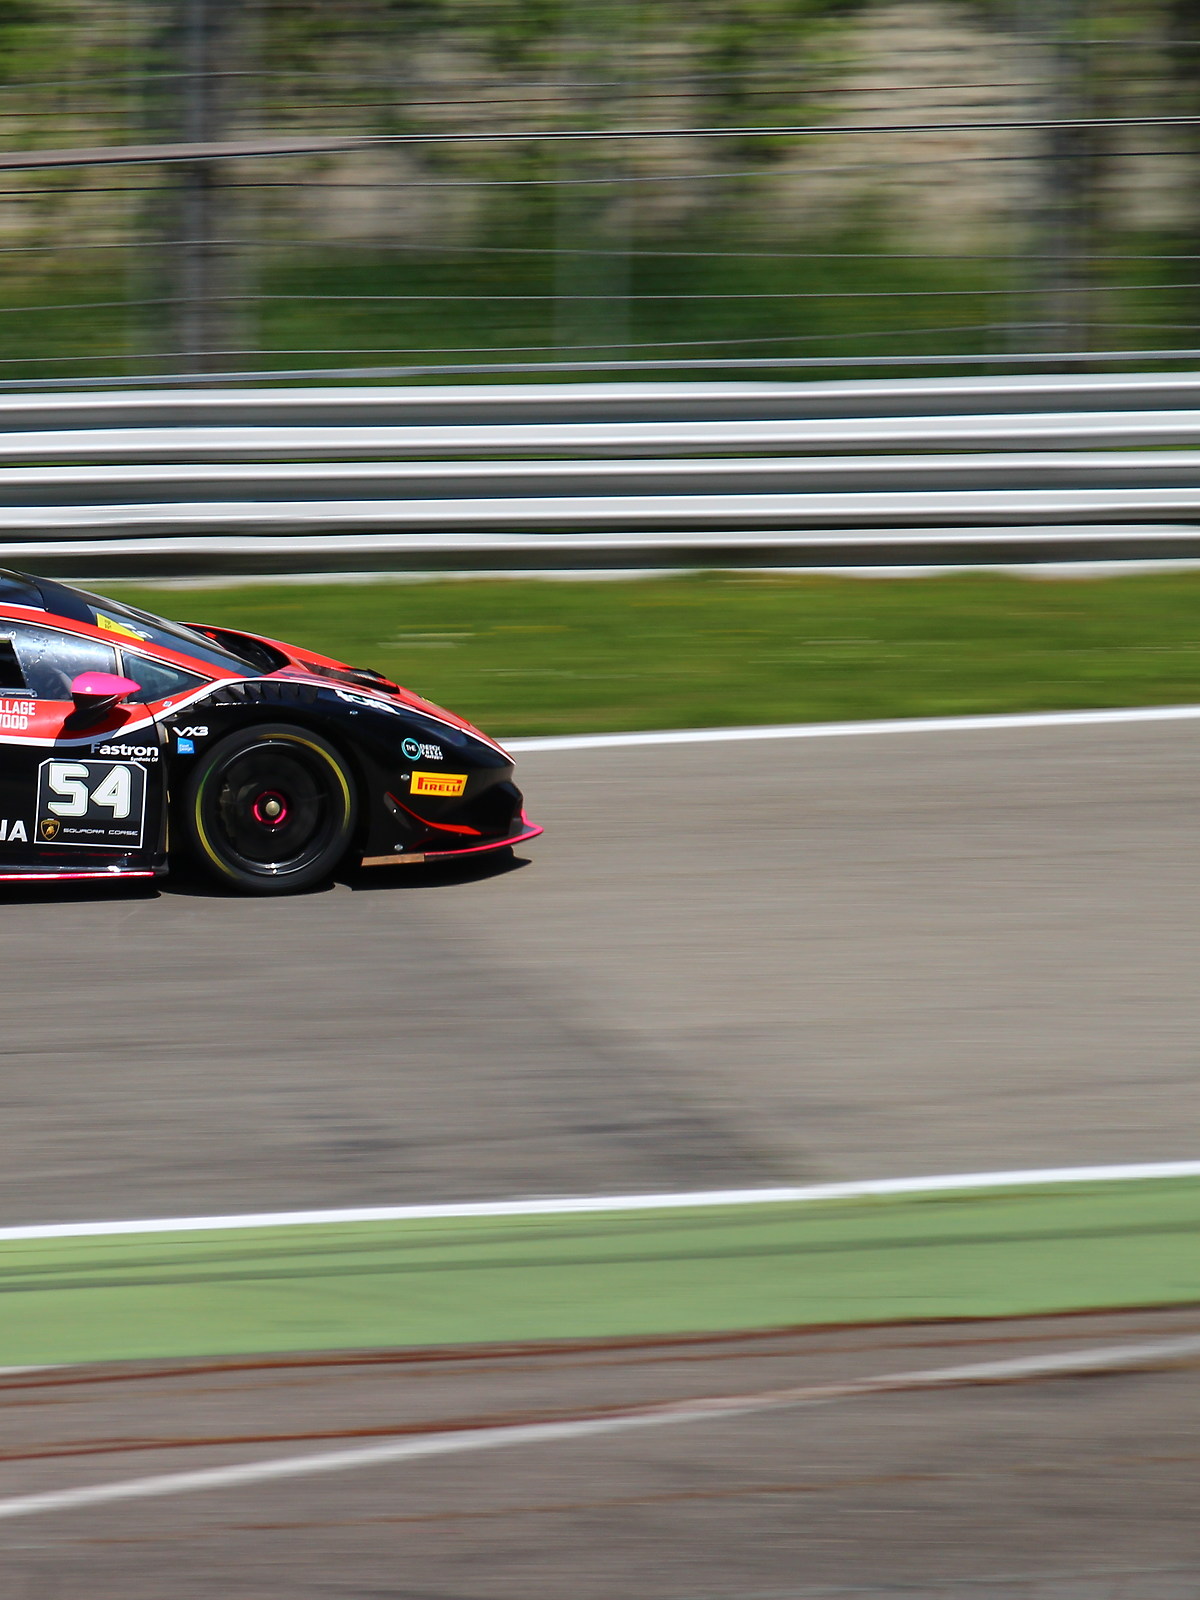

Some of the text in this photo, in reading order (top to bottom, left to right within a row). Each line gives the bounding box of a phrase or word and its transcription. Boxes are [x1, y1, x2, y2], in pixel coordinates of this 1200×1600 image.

[172, 726, 209, 737] VX3
[91, 742, 159, 757] Fastron
[47, 762, 132, 819] 54
[417, 777, 463, 792] PIRELLI
